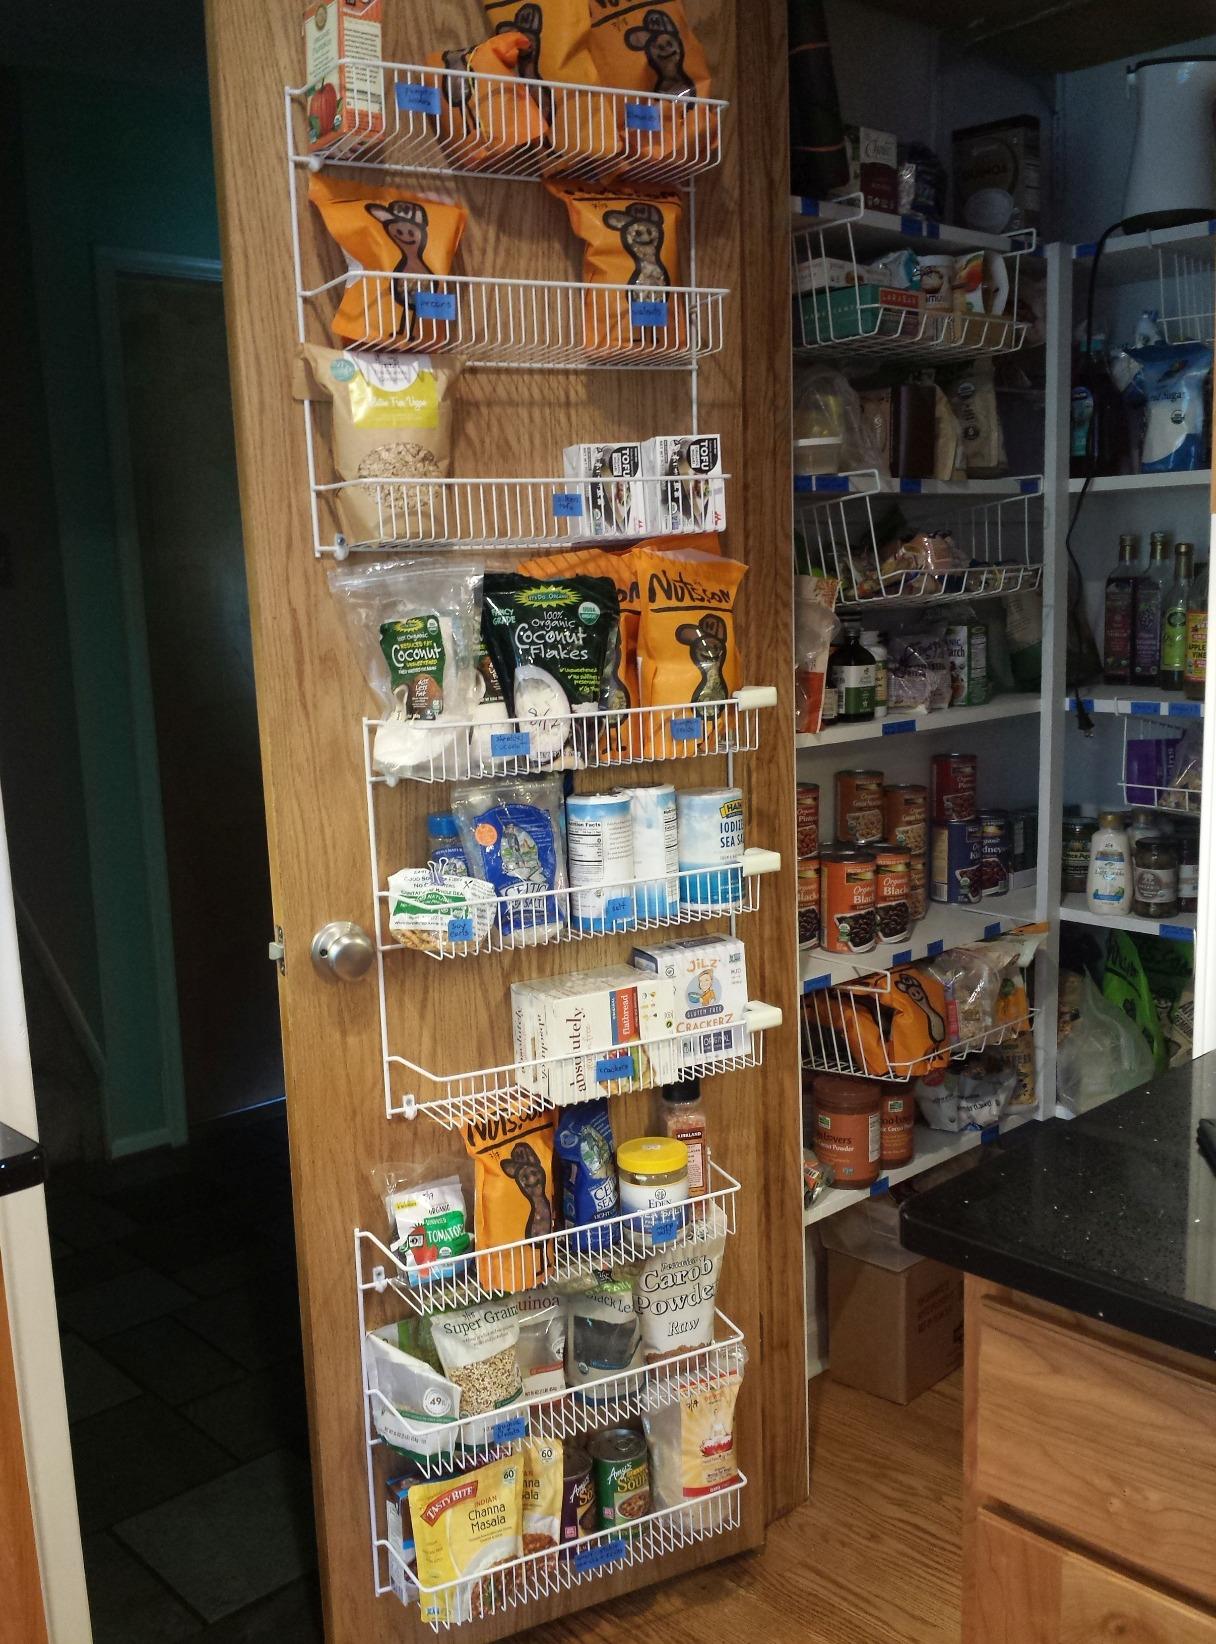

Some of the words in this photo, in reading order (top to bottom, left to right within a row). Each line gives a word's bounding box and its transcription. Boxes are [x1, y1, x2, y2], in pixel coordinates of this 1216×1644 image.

[621, 448, 631, 477] TOFU
[701, 440, 709, 470] TOFU
[531, 618, 575, 630] Organic
[544, 611, 563, 620] 100%
[515, 623, 587, 649] Coconut
[391, 642, 441, 668] Coconut
[530, 645, 588, 660] Flakes
[720, 837, 735, 849] SEA
[621, 993, 632, 1036] flatbread
[832, 1144, 855, 1152] Powder
[640, 1254, 714, 1293] Carob
[518, 1295, 560, 1312] uinoa
[443, 1318, 481, 1336] Super
[667, 1317, 700, 1338] Raw
[541, 1448, 553, 1458] 60
[503, 1469, 515, 1480] 60
[607, 1461, 632, 1485] Amy's
[426, 1496, 452, 1520] TASTY
[452, 1485, 474, 1501] BITE
[473, 1494, 498, 1508] INDIAN
[579, 1490, 593, 1505] So
[468, 1502, 506, 1521] Channa
[471, 1514, 506, 1534] Masala
